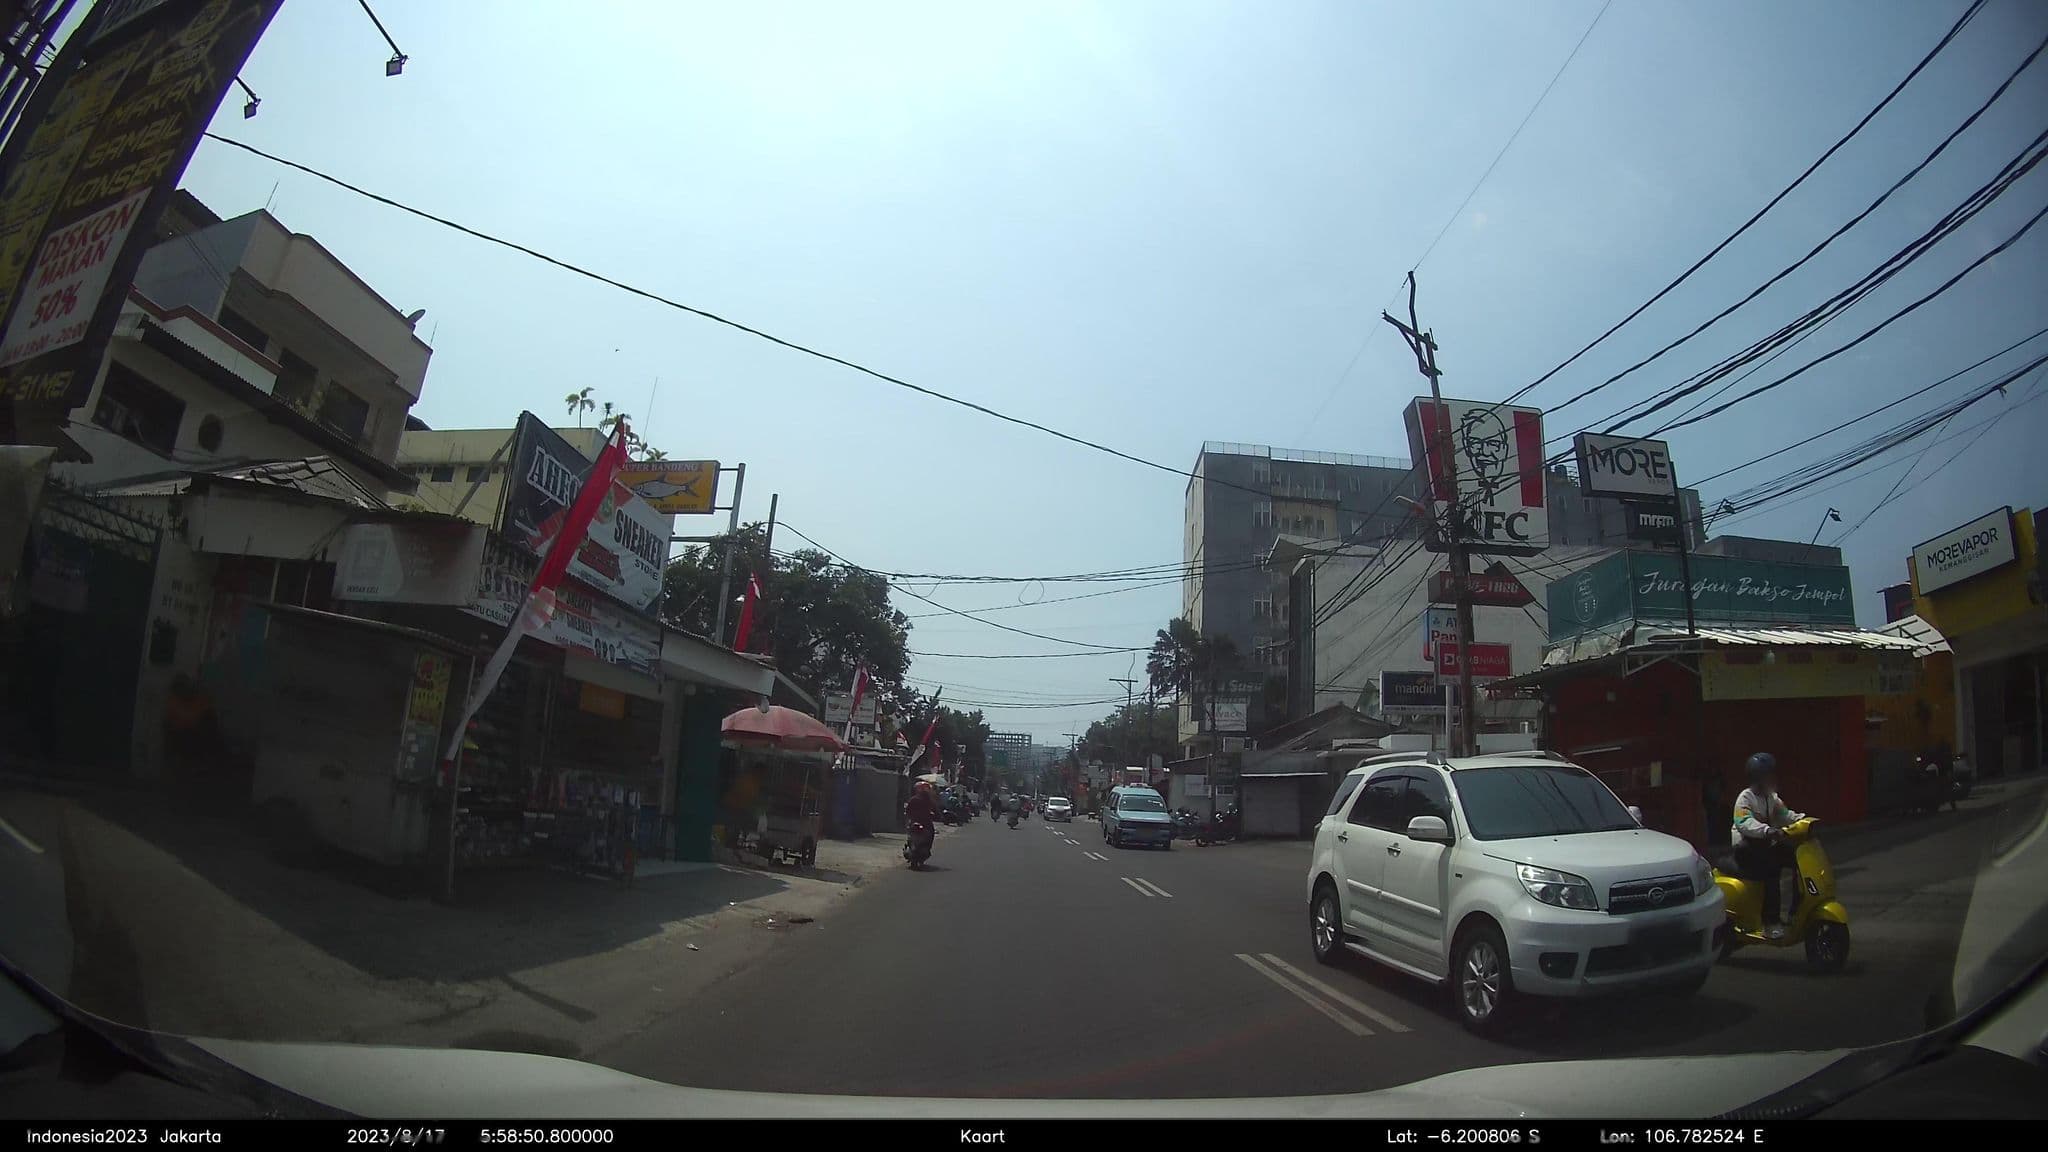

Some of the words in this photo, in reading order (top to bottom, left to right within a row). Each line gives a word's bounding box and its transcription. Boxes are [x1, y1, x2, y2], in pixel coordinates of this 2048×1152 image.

[83, 113, 184, 169] SAMBIL
[61, 148, 176, 208] KONSER
[38, 199, 141, 268] DISKON
[37, 236, 113, 290] MAKAN
[29, 280, 84, 330] 50%
[651, 462, 698, 472] BANDENG
[1590, 445, 1667, 479] MORE
[1926, 527, 1999, 569] MOREVAPOR
[1736, 577, 1792, 601] Bakso
[1792, 584, 1845, 606] Jempol
[1431, 629, 1457, 641] Pan
